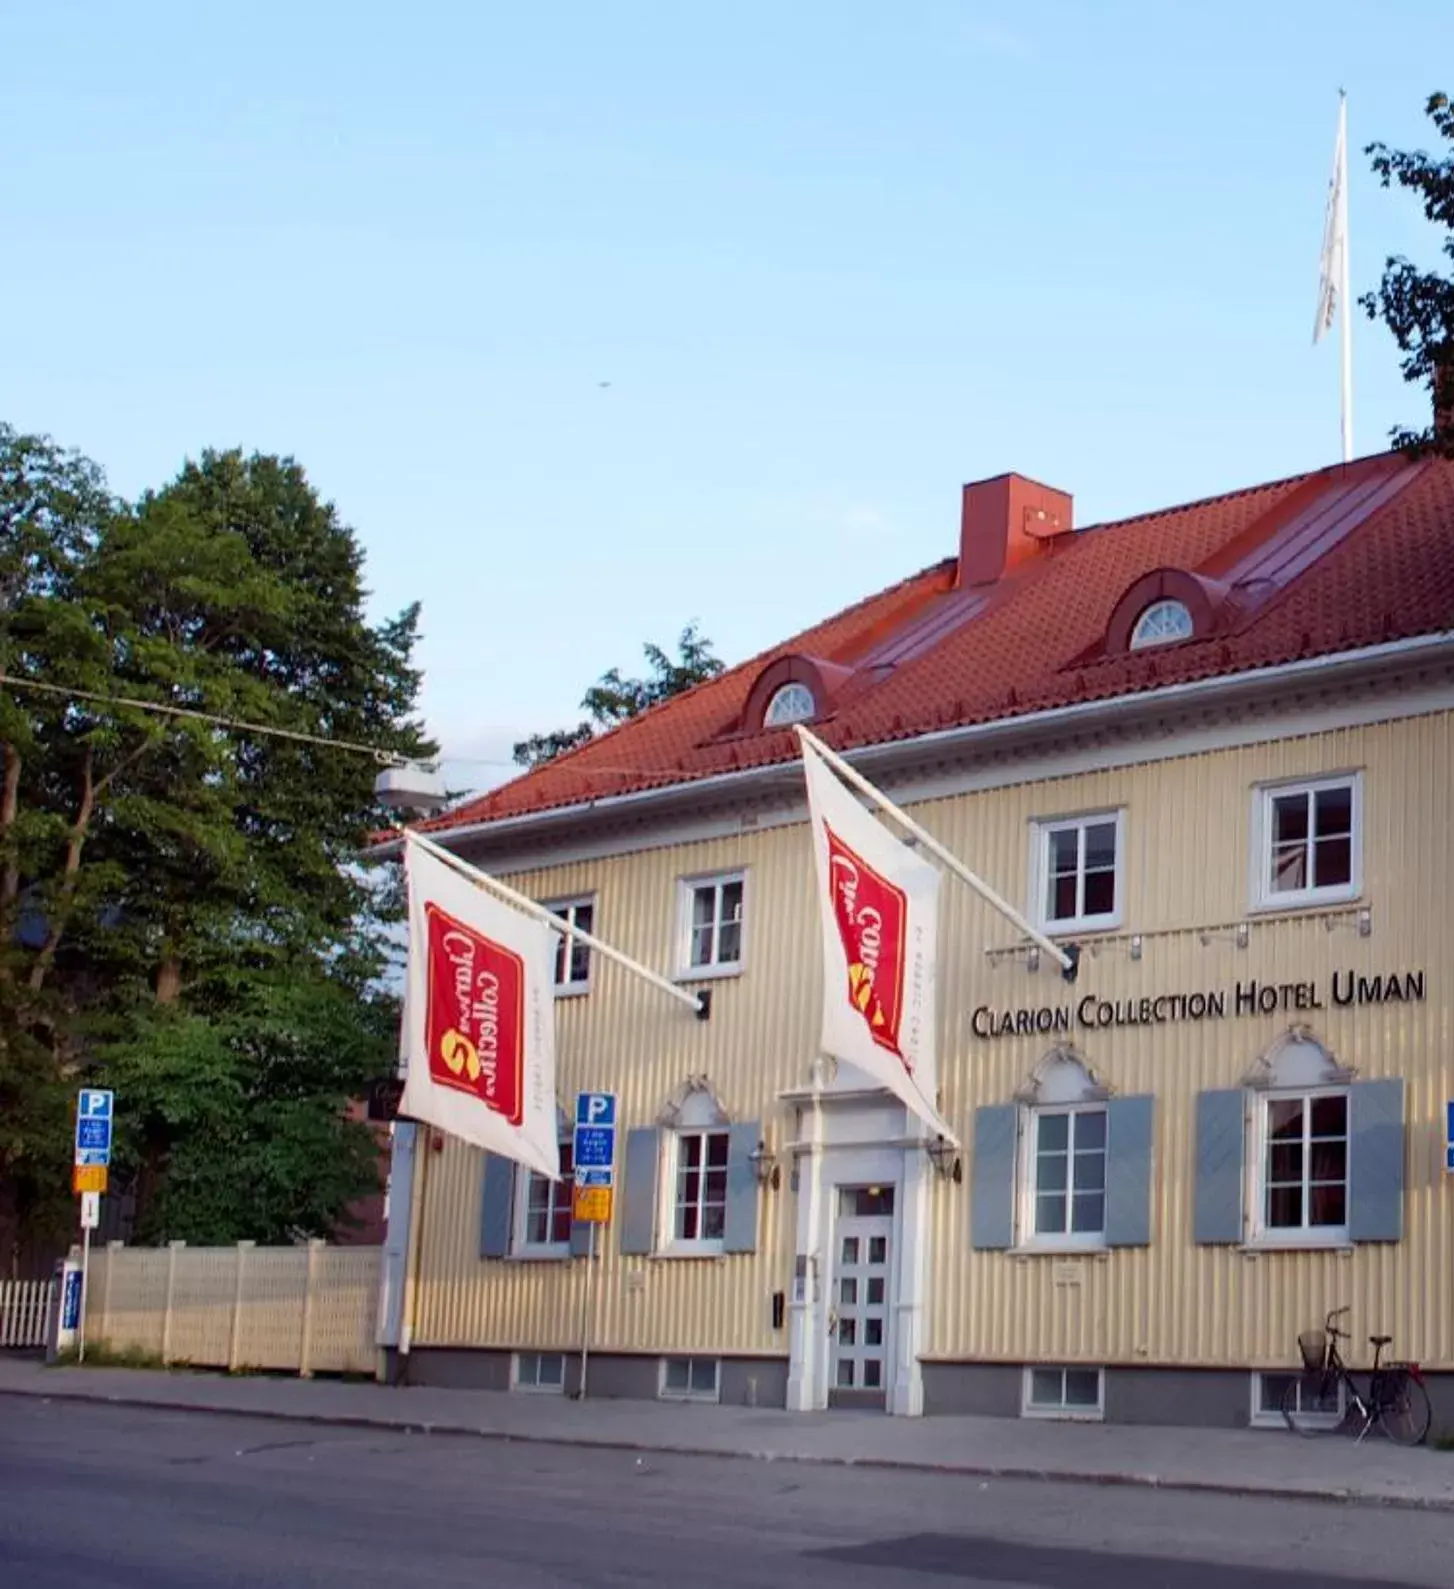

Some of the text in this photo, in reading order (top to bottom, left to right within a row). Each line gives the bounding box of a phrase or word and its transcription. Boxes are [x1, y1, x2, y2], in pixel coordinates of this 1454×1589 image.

[971, 969, 1424, 1038] CLARION COLLECTION HOTEL UMAN
[87, 1093, 106, 1116] P
[587, 1095, 609, 1125] P
